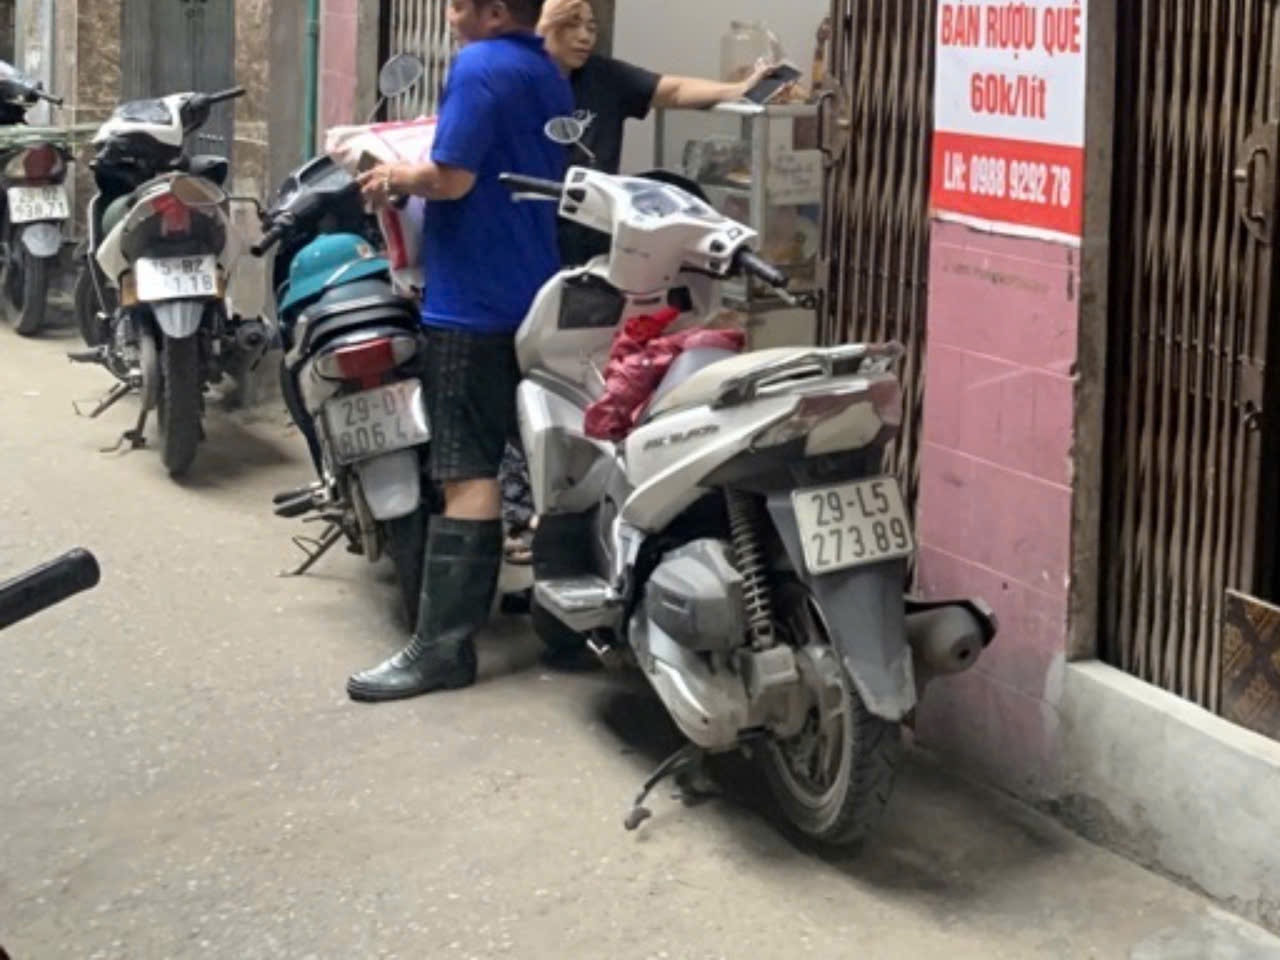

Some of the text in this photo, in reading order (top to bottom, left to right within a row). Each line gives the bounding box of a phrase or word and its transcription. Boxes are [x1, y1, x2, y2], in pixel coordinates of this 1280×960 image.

[985, 2, 1036, 60] RƯỢU
[1009, 159, 1047, 204] 9292
[1049, 164, 1071, 208] 78
[811, 481, 890, 527] 29-L5
[811, 517, 908, 567] 273.89
